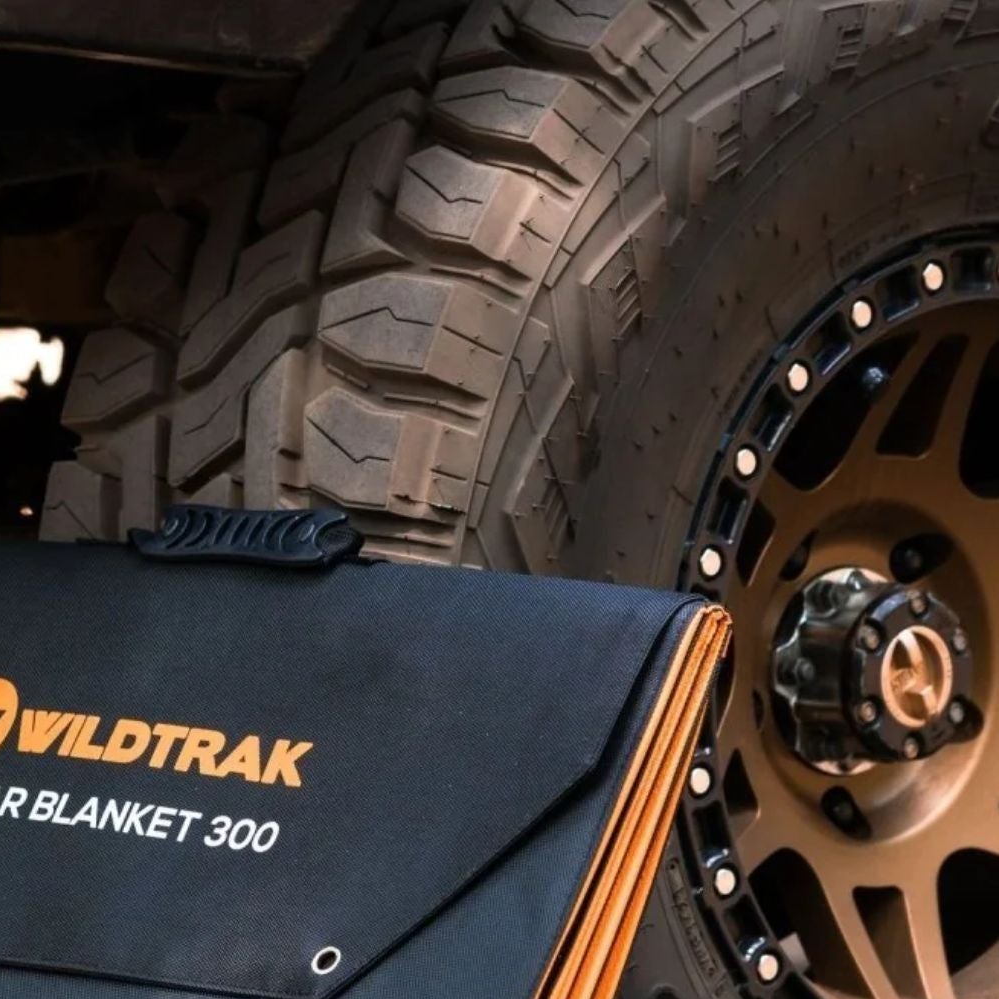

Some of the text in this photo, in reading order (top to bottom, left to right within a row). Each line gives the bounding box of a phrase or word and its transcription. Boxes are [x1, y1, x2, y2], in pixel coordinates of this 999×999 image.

[17, 709, 313, 787] WILDTRAK
[28, 790, 202, 843] BLANKET
[203, 815, 280, 853] 300
